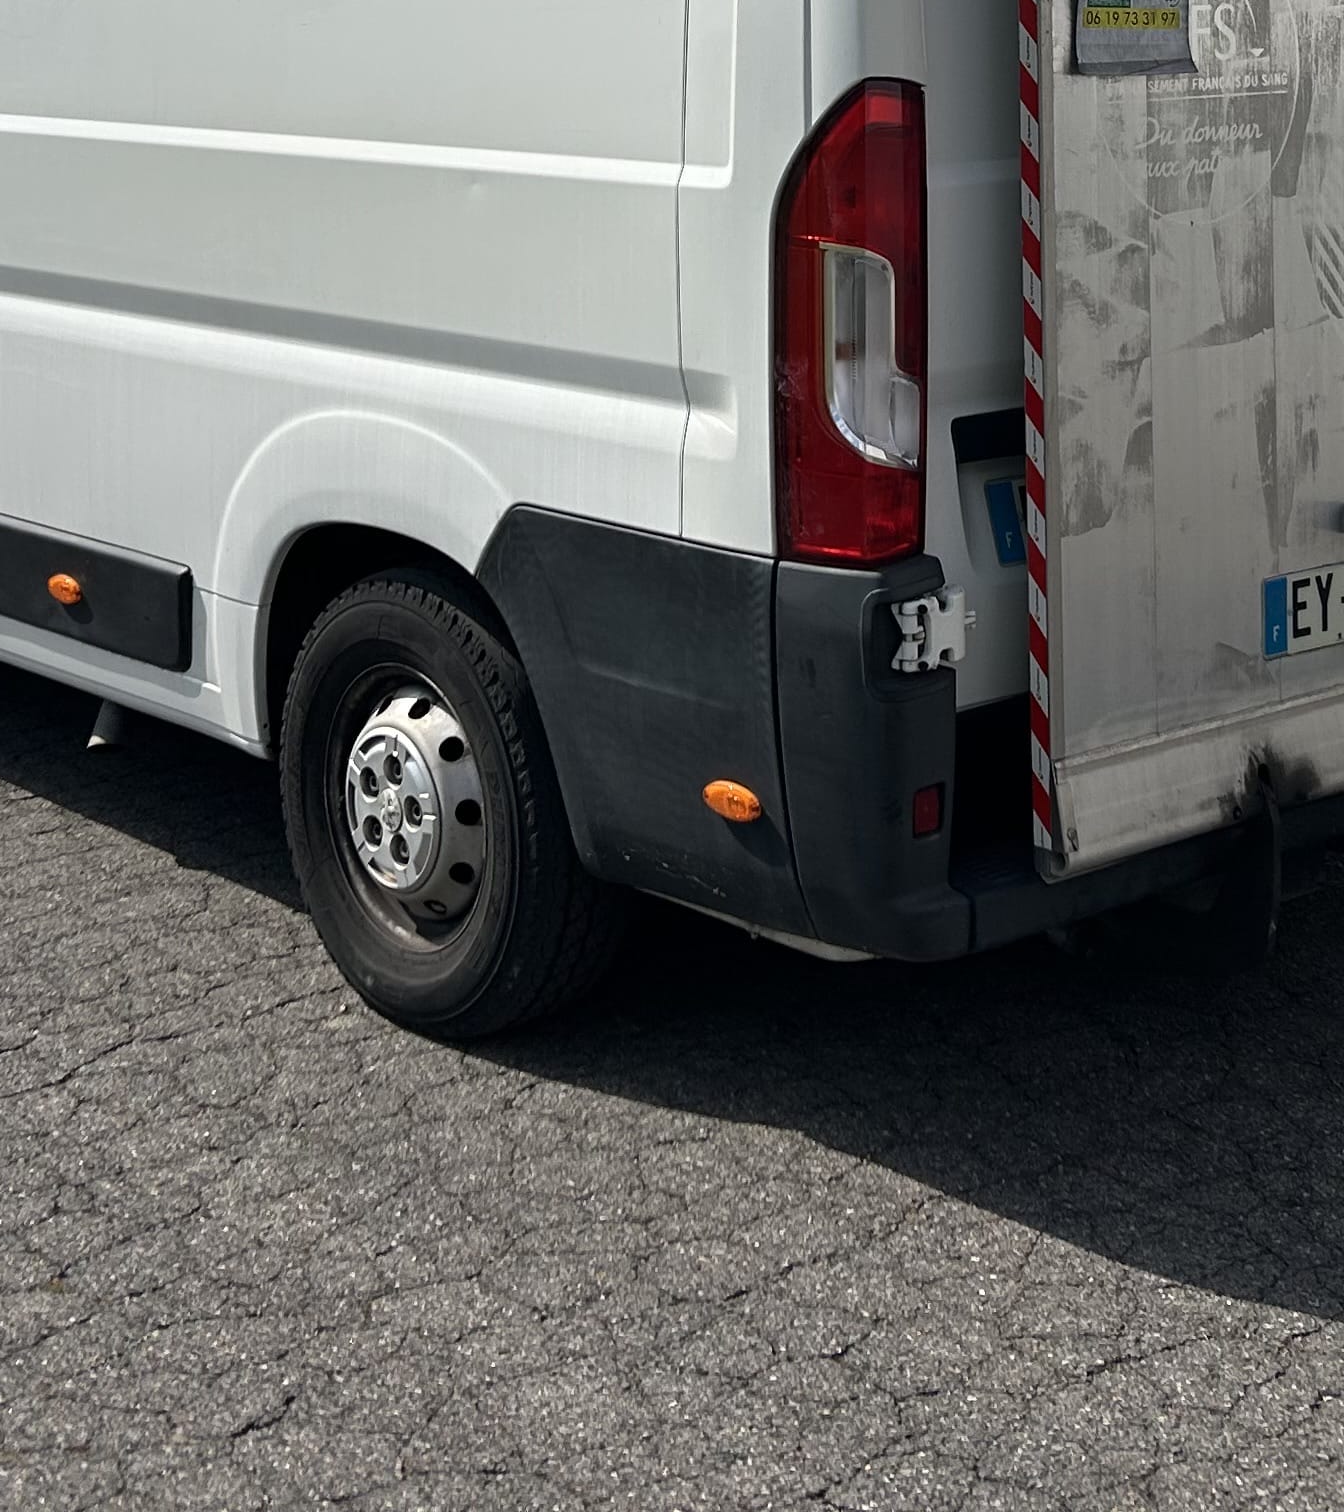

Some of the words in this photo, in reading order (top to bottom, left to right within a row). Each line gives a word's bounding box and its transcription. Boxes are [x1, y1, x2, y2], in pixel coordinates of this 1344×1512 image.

[1086, 10, 1101, 25] 06
[1106, 11, 1119, 25] 19
[1123, 11, 1138, 25] 73
[1142, 11, 1156, 25] 31
[1161, 11, 1176, 25] 97
[1244, 74, 1258, 88] DU
[1261, 72, 1288, 86] SANG
